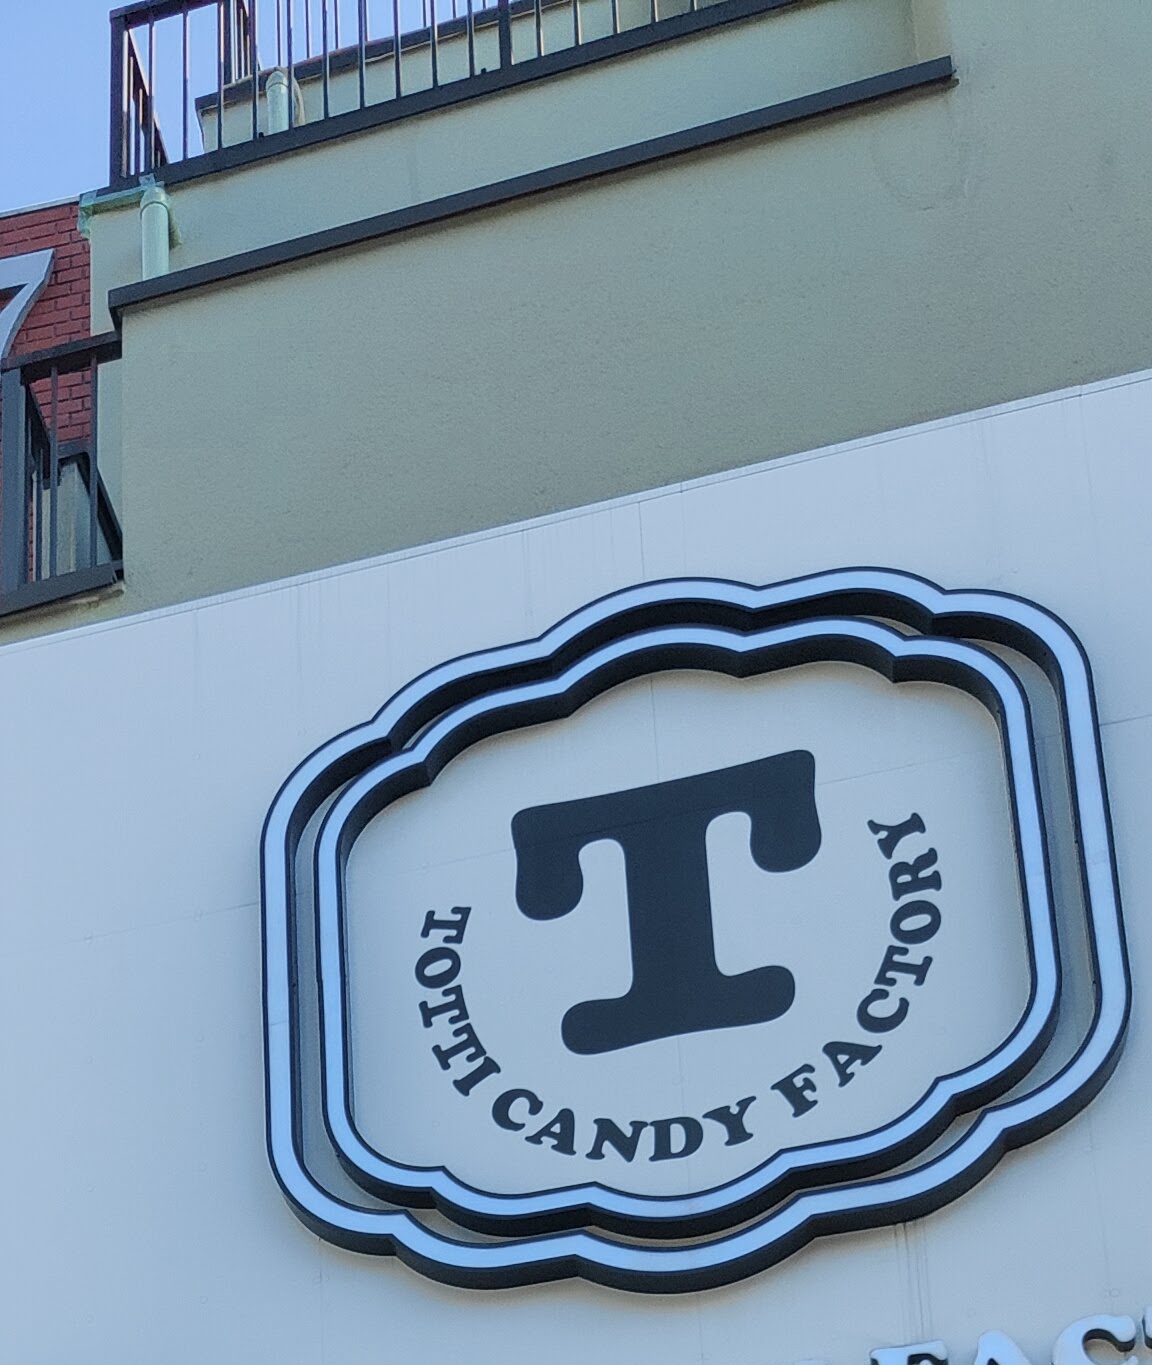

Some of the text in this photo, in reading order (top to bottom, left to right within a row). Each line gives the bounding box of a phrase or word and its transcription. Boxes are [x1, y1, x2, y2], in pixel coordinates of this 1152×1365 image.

[414, 813, 943, 1162] TOTTI CANDY FACTORY
[511, 749, 822, 1055] T
